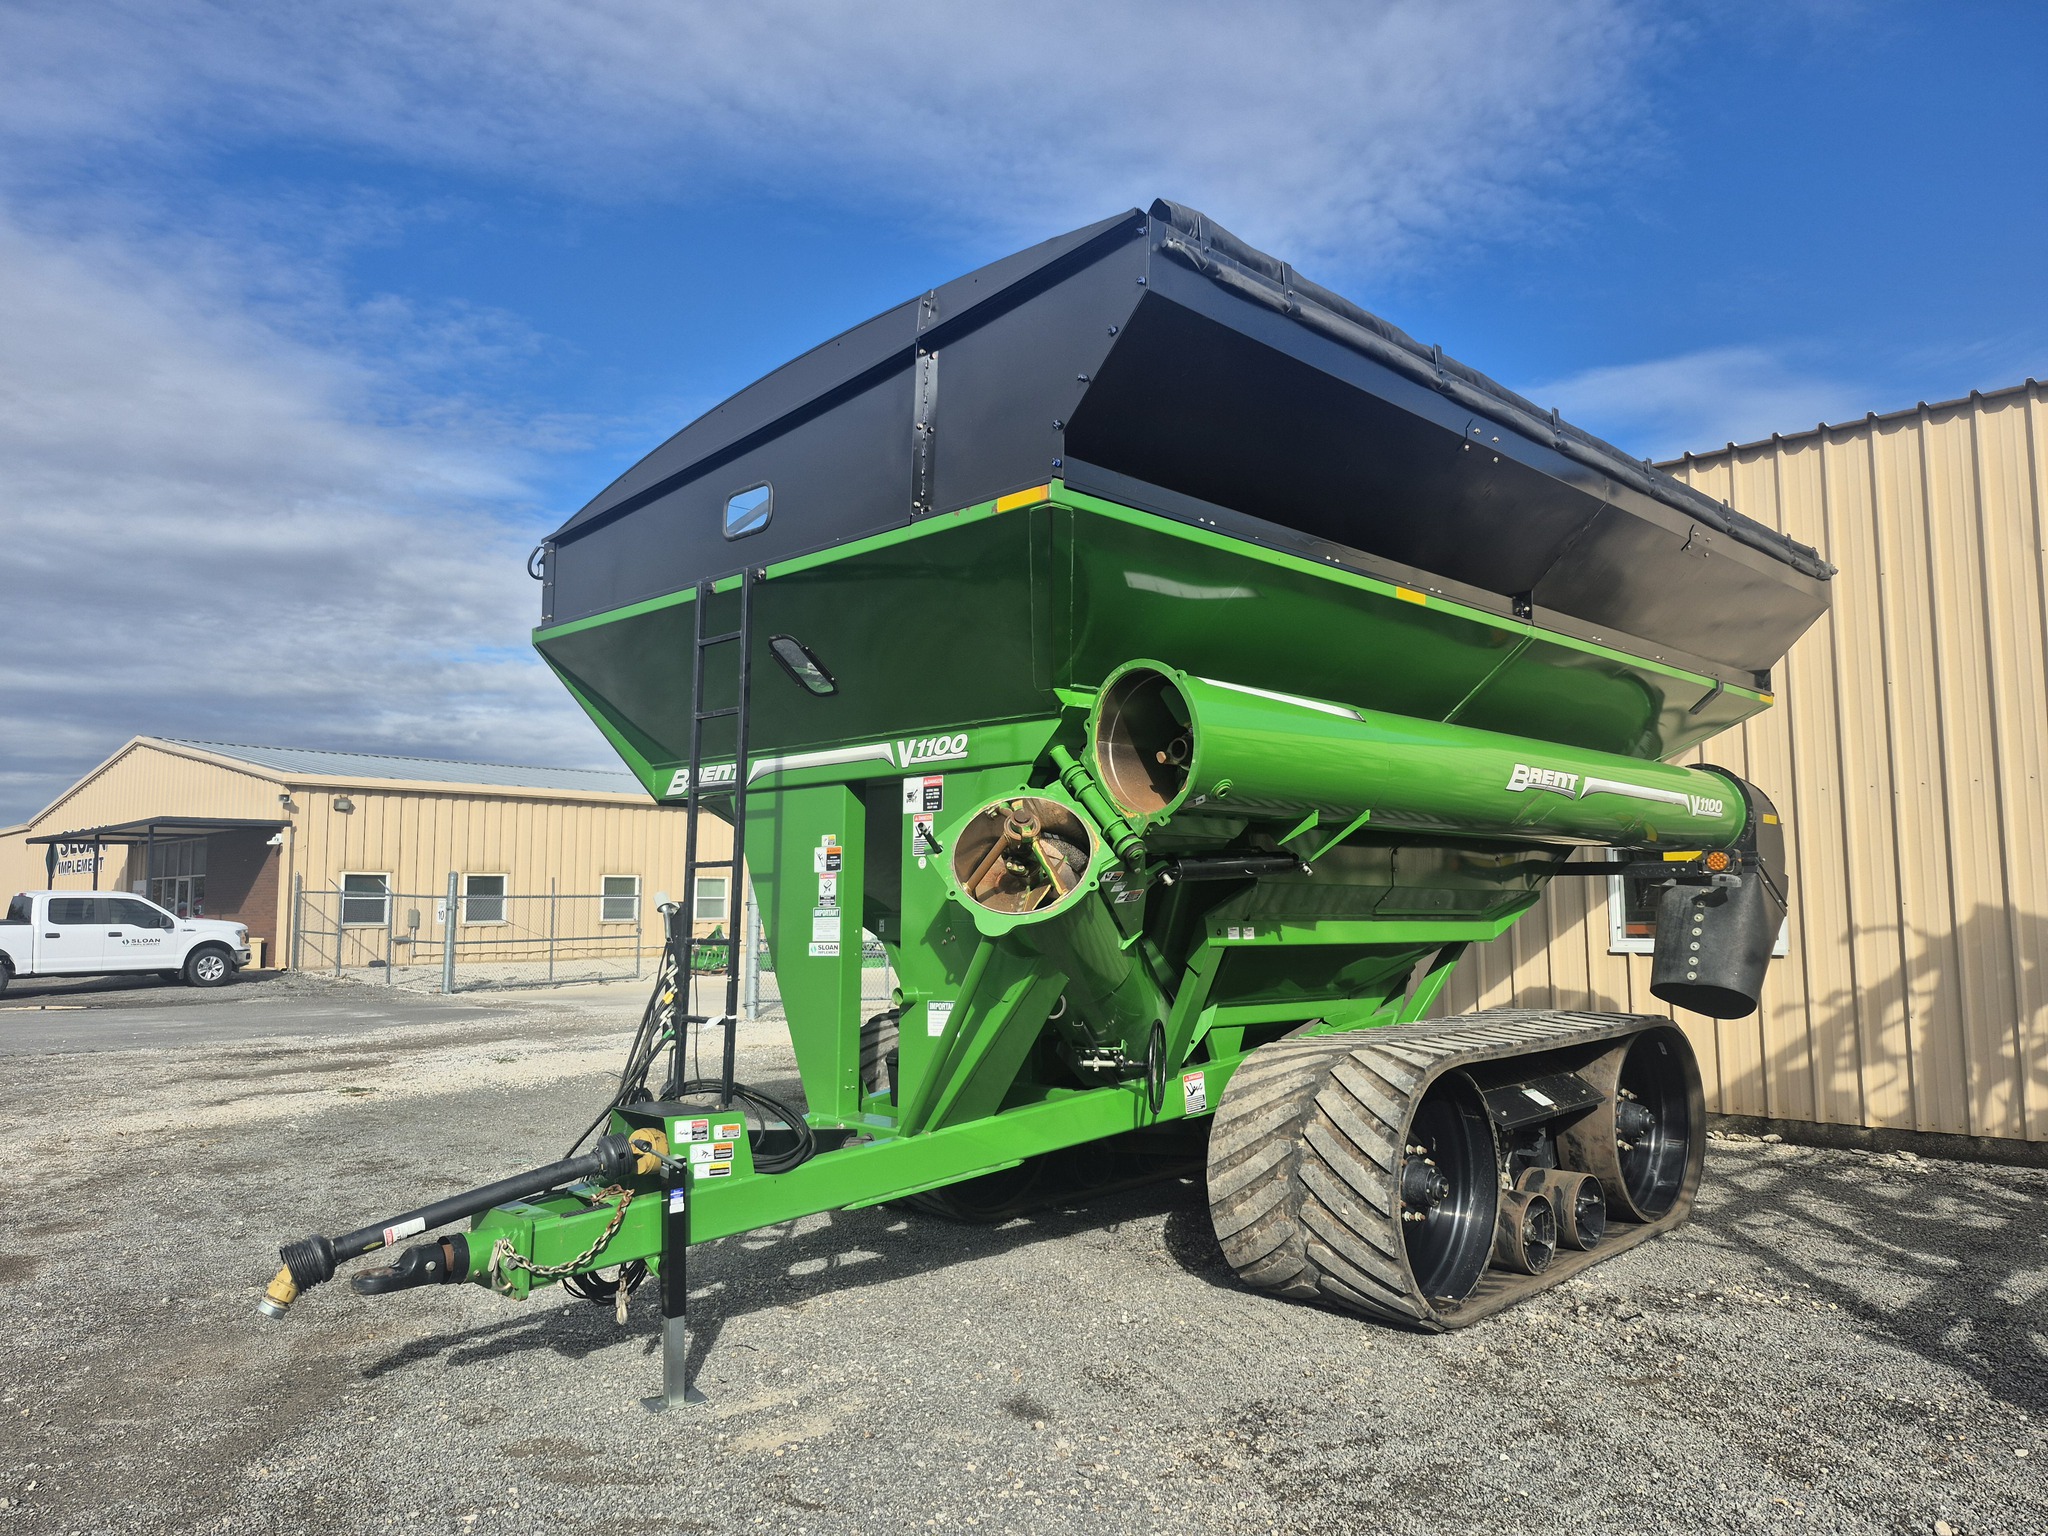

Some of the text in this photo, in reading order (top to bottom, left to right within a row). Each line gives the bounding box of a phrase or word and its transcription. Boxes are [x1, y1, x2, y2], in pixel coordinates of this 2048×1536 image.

[897, 734, 968, 769] V1100
[1505, 763, 1579, 798] BRENT
[1690, 794, 1722, 817] V1100
[58, 857, 104, 874] IMPLEMET
